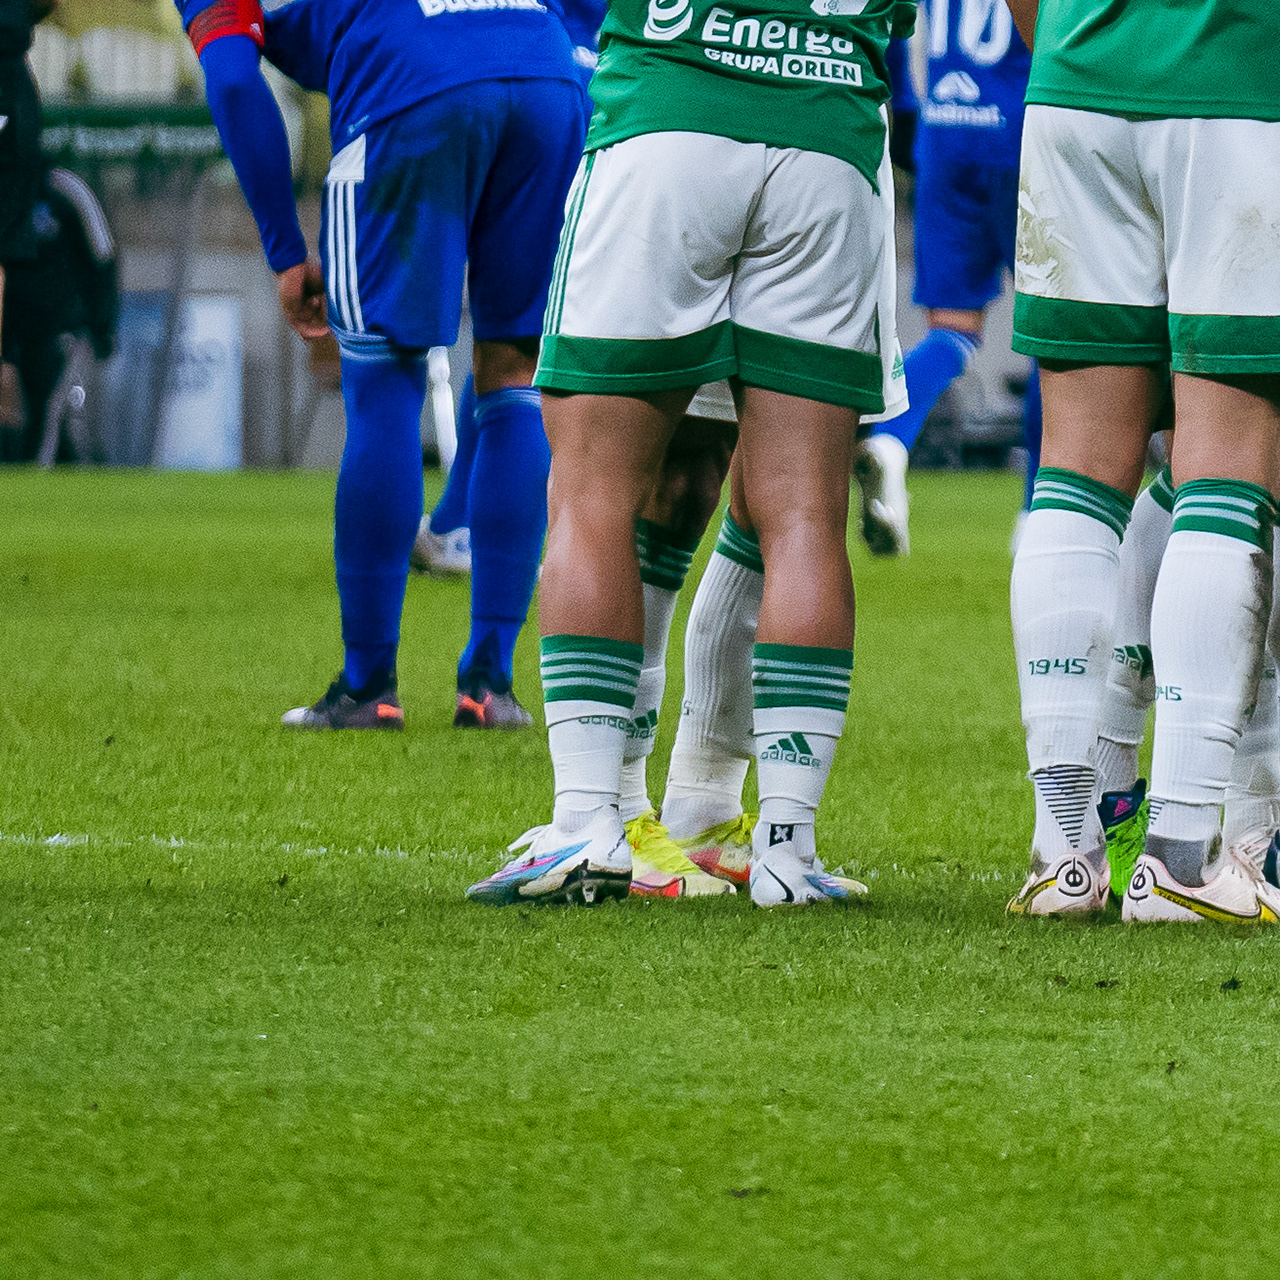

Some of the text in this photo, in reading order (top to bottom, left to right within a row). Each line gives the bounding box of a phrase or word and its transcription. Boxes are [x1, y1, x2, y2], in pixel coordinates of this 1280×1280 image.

[703, 47, 857, 83] GRUPA ORLEN
[1028, 658, 1089, 676] 1945
[760, 748, 821, 769] adidas
